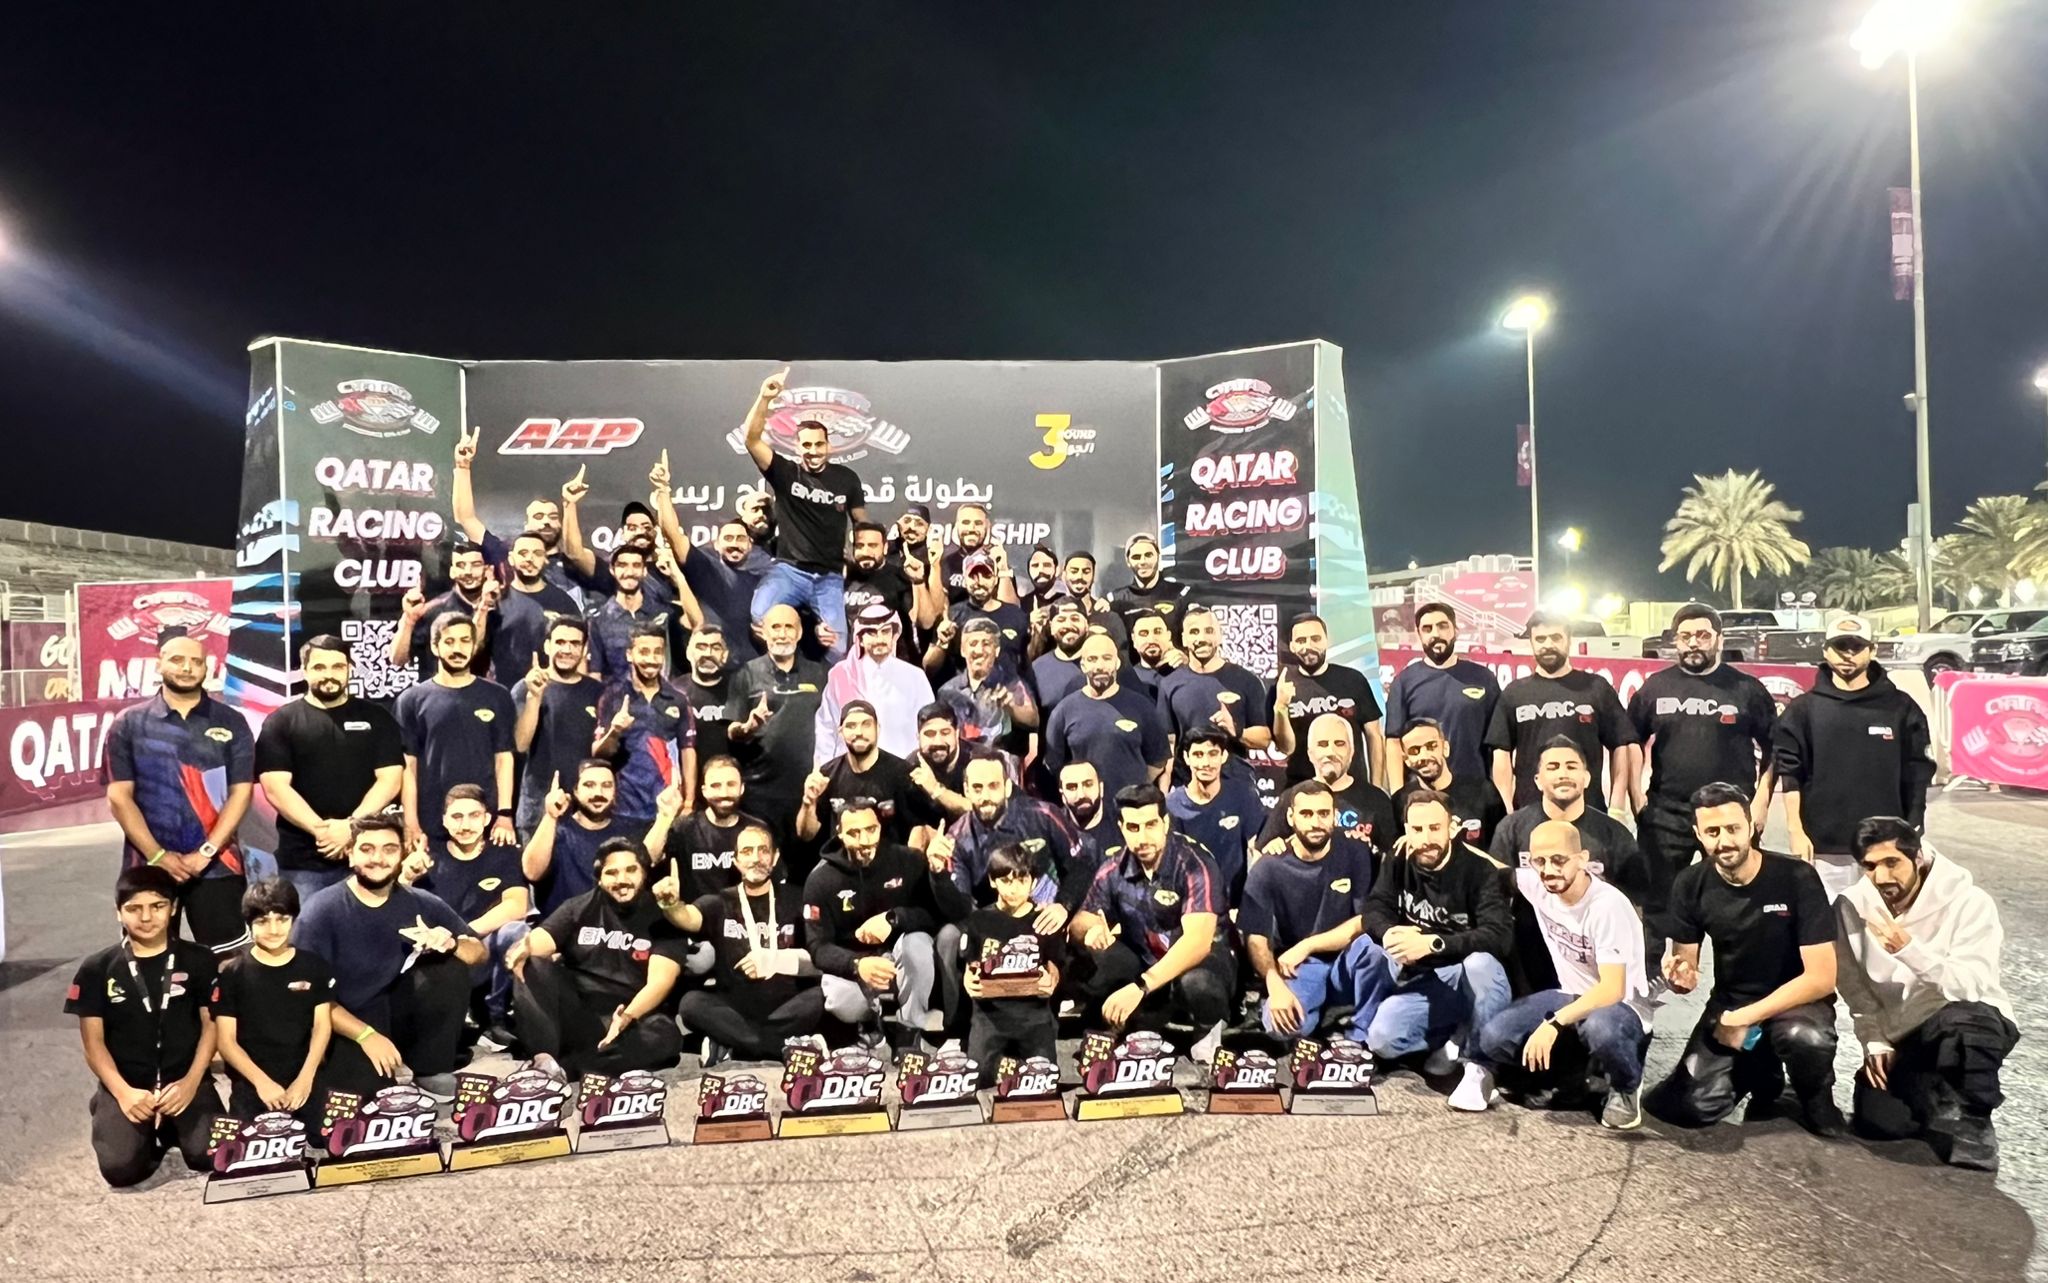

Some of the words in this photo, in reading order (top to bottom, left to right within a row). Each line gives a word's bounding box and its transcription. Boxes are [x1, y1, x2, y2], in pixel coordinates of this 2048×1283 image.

[497, 418, 645, 455] AAP
[1028, 413, 1071, 470] 3
[315, 457, 434, 491] QATAR
[1190, 450, 1295, 488] QATAR
[904, 475, 993, 510] بطولة
[308, 507, 444, 540] RACING
[1185, 497, 1303, 531] RACING
[333, 559, 422, 588] CLUB
[1205, 546, 1284, 576] CLUB
[1516, 701, 1576, 723] BMRC
[1656, 697, 1718, 715] BMRC
[927, 1072, 979, 1095] DRC
[1020, 1072, 1059, 1091] DRC
[1115, 1057, 1175, 1083] DRC
[1237, 1068, 1277, 1084] DRC
[1322, 1063, 1375, 1082] DRC
[821, 1073, 885, 1100] DRC
[495, 1096, 564, 1127] DRC
[610, 1092, 666, 1116] DRC
[724, 1092, 767, 1110] DRC
[364, 1112, 436, 1144] DRC
[244, 1135, 306, 1161] DRC
